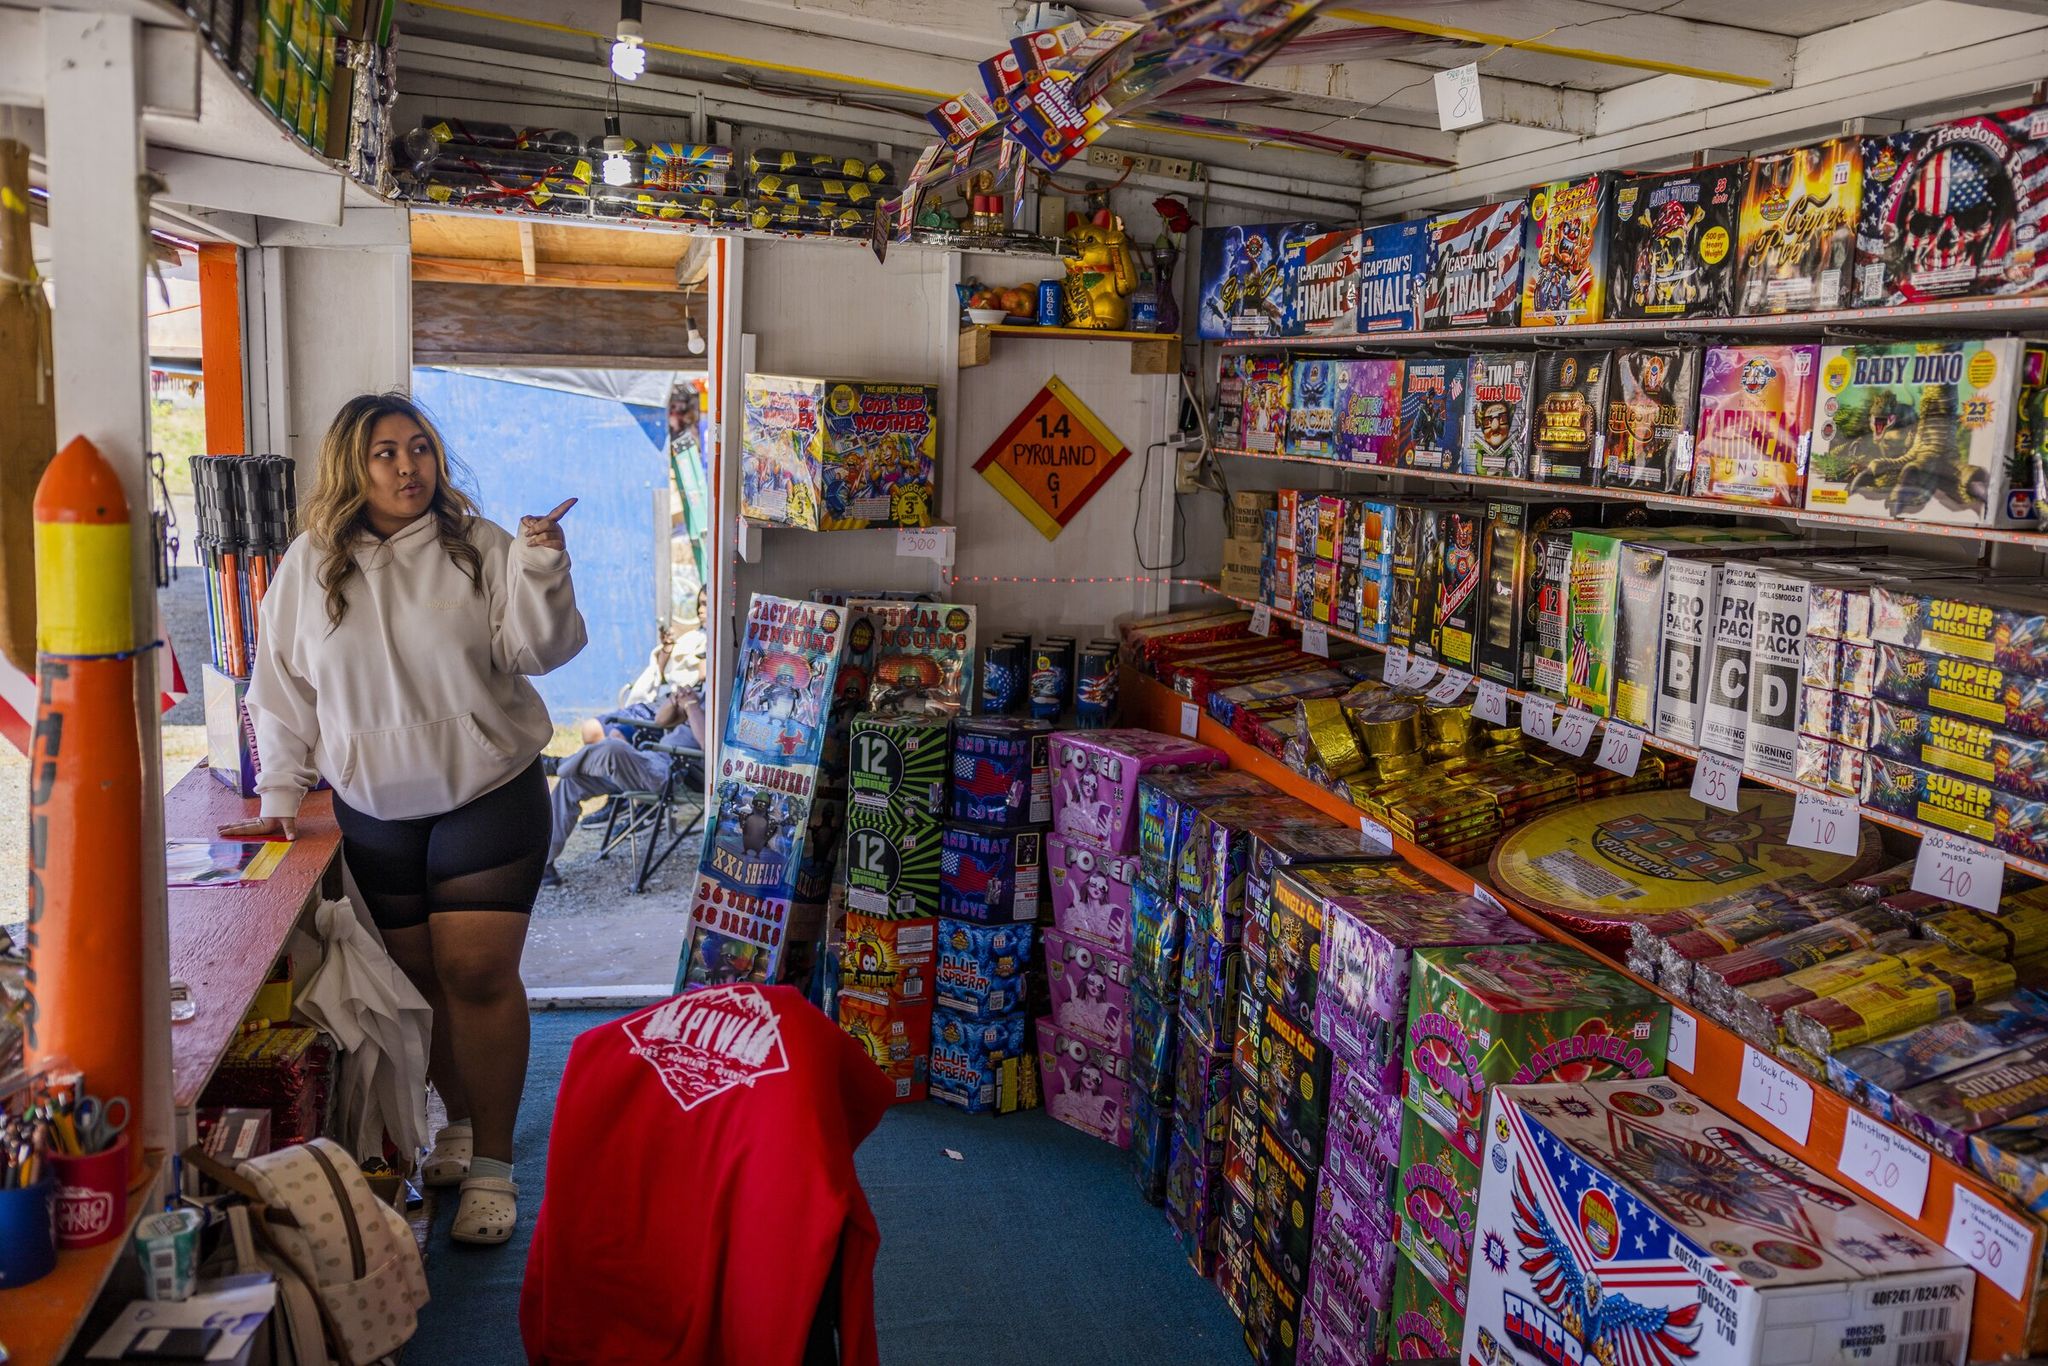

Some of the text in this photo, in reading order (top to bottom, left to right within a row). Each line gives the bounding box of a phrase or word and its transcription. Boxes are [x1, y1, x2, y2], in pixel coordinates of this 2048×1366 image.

[1034, 92, 1071, 130] JUMBO
[1040, 77, 1087, 130] MORNING
[1916, 122, 2031, 213] of Freedoms Past
[1046, 286, 1055, 316] pepsi
[1296, 280, 1344, 322] FINALE
[1360, 273, 1411, 318] FINALE
[1445, 270, 1497, 316] FINALE
[1488, 364, 1512, 386] TWO
[1853, 352, 1964, 386] BABY DINO
[900, 386, 924, 394] BIGGER
[1408, 374, 1446, 396] Dandy
[1475, 383, 1523, 403] Guns Up
[862, 396, 927, 414] ONE BAD
[1966, 415, 1986, 423] SHOTS
[1968, 401, 1987, 416] 23
[854, 414, 928, 433] MOTHER
[1035, 413, 1071, 439] 1.4
[1012, 443, 1096, 467] PYROLAND
[899, 484, 929, 502] BIGGER
[1047, 471, 1061, 492] G
[1051, 495, 1059, 509] 1
[1726, 568, 1743, 578] PYRO
[1545, 589, 1559, 613] 12
[1667, 592, 1704, 612] PRO
[1777, 583, 1804, 593] PLANET
[752, 600, 817, 628] TACTICAL
[1666, 612, 1702, 635] PACK
[1757, 610, 1801, 637] PRO
[1929, 599, 1994, 627] SUPER
[749, 622, 836, 654] PENGUINS
[1932, 619, 1986, 640] MISSILE
[1755, 635, 1800, 657] PACK
[1536, 658, 1565, 672] WARNING
[1668, 649, 1693, 691] B
[1780, 656, 1800, 665] SHELLS
[1906, 662, 1926, 676] TNT
[1937, 658, 2004, 688] SUPER
[1719, 658, 1747, 699] C
[1940, 677, 1995, 701] MISSILE
[1760, 674, 1788, 717] D
[1660, 713, 1695, 730] WARNING
[1706, 722, 1745, 740] WARNING
[1898, 717, 1917, 731] TNT
[1929, 716, 1994, 747] SUPER
[859, 736, 888, 776] 12
[956, 735, 1027, 756] AND THAT
[1751, 743, 1792, 761] WARNING
[1932, 735, 1986, 759] MISSILE
[1060, 744, 1123, 783] POSER
[745, 762, 812, 797] CANISTERS
[1702, 766, 1727, 800] $35
[1895, 775, 1914, 788] TNT
[1926, 773, 1992, 807] SUPER
[954, 802, 1007, 823] I LOVE
[1799, 793, 1809, 805] 25
[1929, 791, 1986, 819] MISSILE
[857, 833, 885, 873] 12
[942, 829, 1011, 855] AND THAT
[713, 846, 783, 886] XXL SHELLS
[1064, 845, 1138, 886] POSER
[698, 881, 785, 924] 36 SHELLS
[941, 896, 989, 919] I LOVE
[1274, 879, 1307, 923] JUNGLE
[691, 903, 781, 948] 48 BREAKS
[942, 955, 979, 975] BLUE
[1061, 937, 1133, 985] POSER
[936, 968, 991, 994] ASPBERRY
[681, 1007, 748, 1054] PNW
[1266, 1003, 1316, 1063] JUNGLE CAT
[629, 1046, 659, 1058] RIVERS
[666, 1052, 709, 1071] MOUNTAINS
[934, 1047, 969, 1068] BLUE
[1055, 1033, 1130, 1078] POSER
[1410, 1012, 1487, 1094] WATERMELON
[1510, 1034, 1655, 1085] WATERMELON
[930, 1061, 981, 1088] SPBERRY
[1417, 1045, 1473, 1111] CRAWL
[1752, 1051, 1800, 1092] Black Cats
[1345, 1077, 1385, 1136] Snow
[1850, 1112, 1891, 1153] Whistling
[1261, 1126, 1307, 1192] JUNGLE CAT
[1344, 1113, 1389, 1186] Spring
[1328, 1212, 1368, 1273] Snow
[1410, 1194, 1464, 1266] CRAWL
[1253, 1242, 1295, 1313] JUNGLE CAT
[1327, 1247, 1371, 1325] Spring
[1697, 1284, 1738, 1327] 1003265
[1716, 1318, 1737, 1346] 1/10
